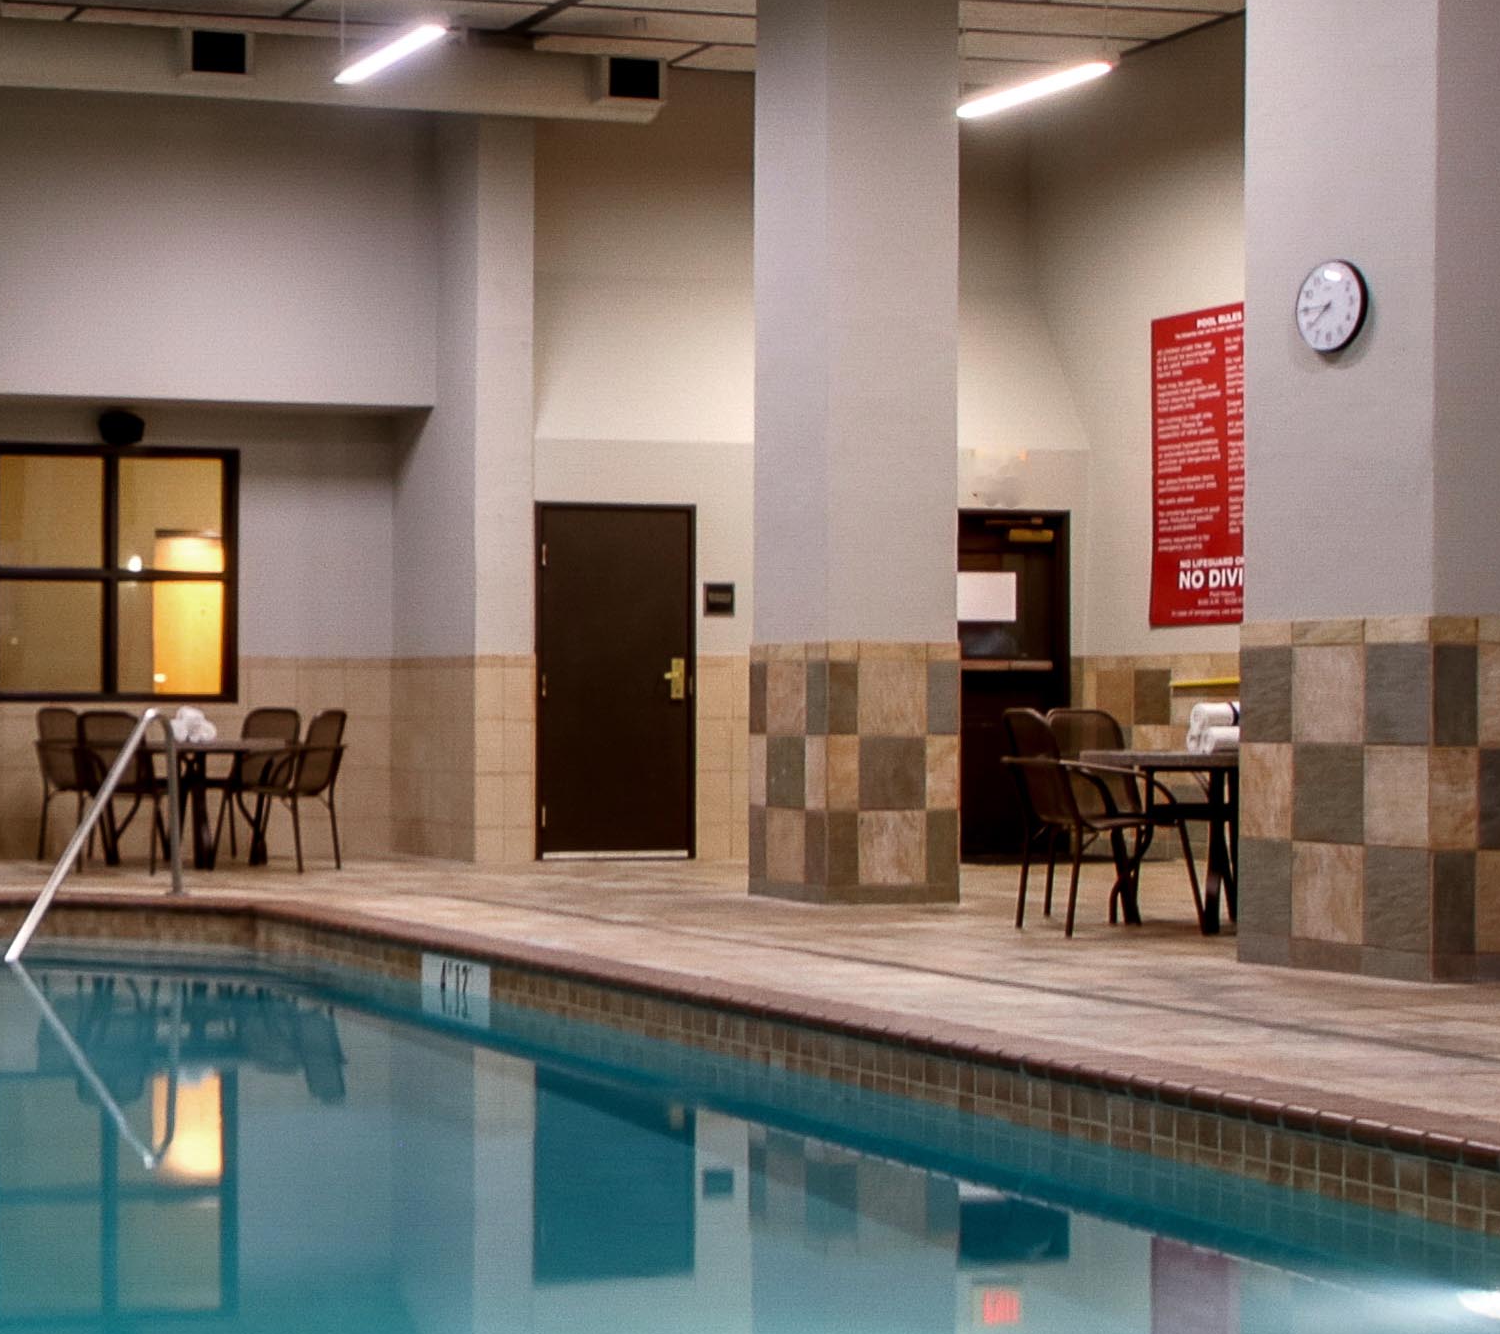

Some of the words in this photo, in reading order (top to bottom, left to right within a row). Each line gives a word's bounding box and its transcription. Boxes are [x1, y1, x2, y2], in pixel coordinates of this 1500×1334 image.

[1179, 559, 1192, 570] NO
[1192, 556, 1234, 569] LIFEGUARD
[1179, 570, 1205, 590] NO
